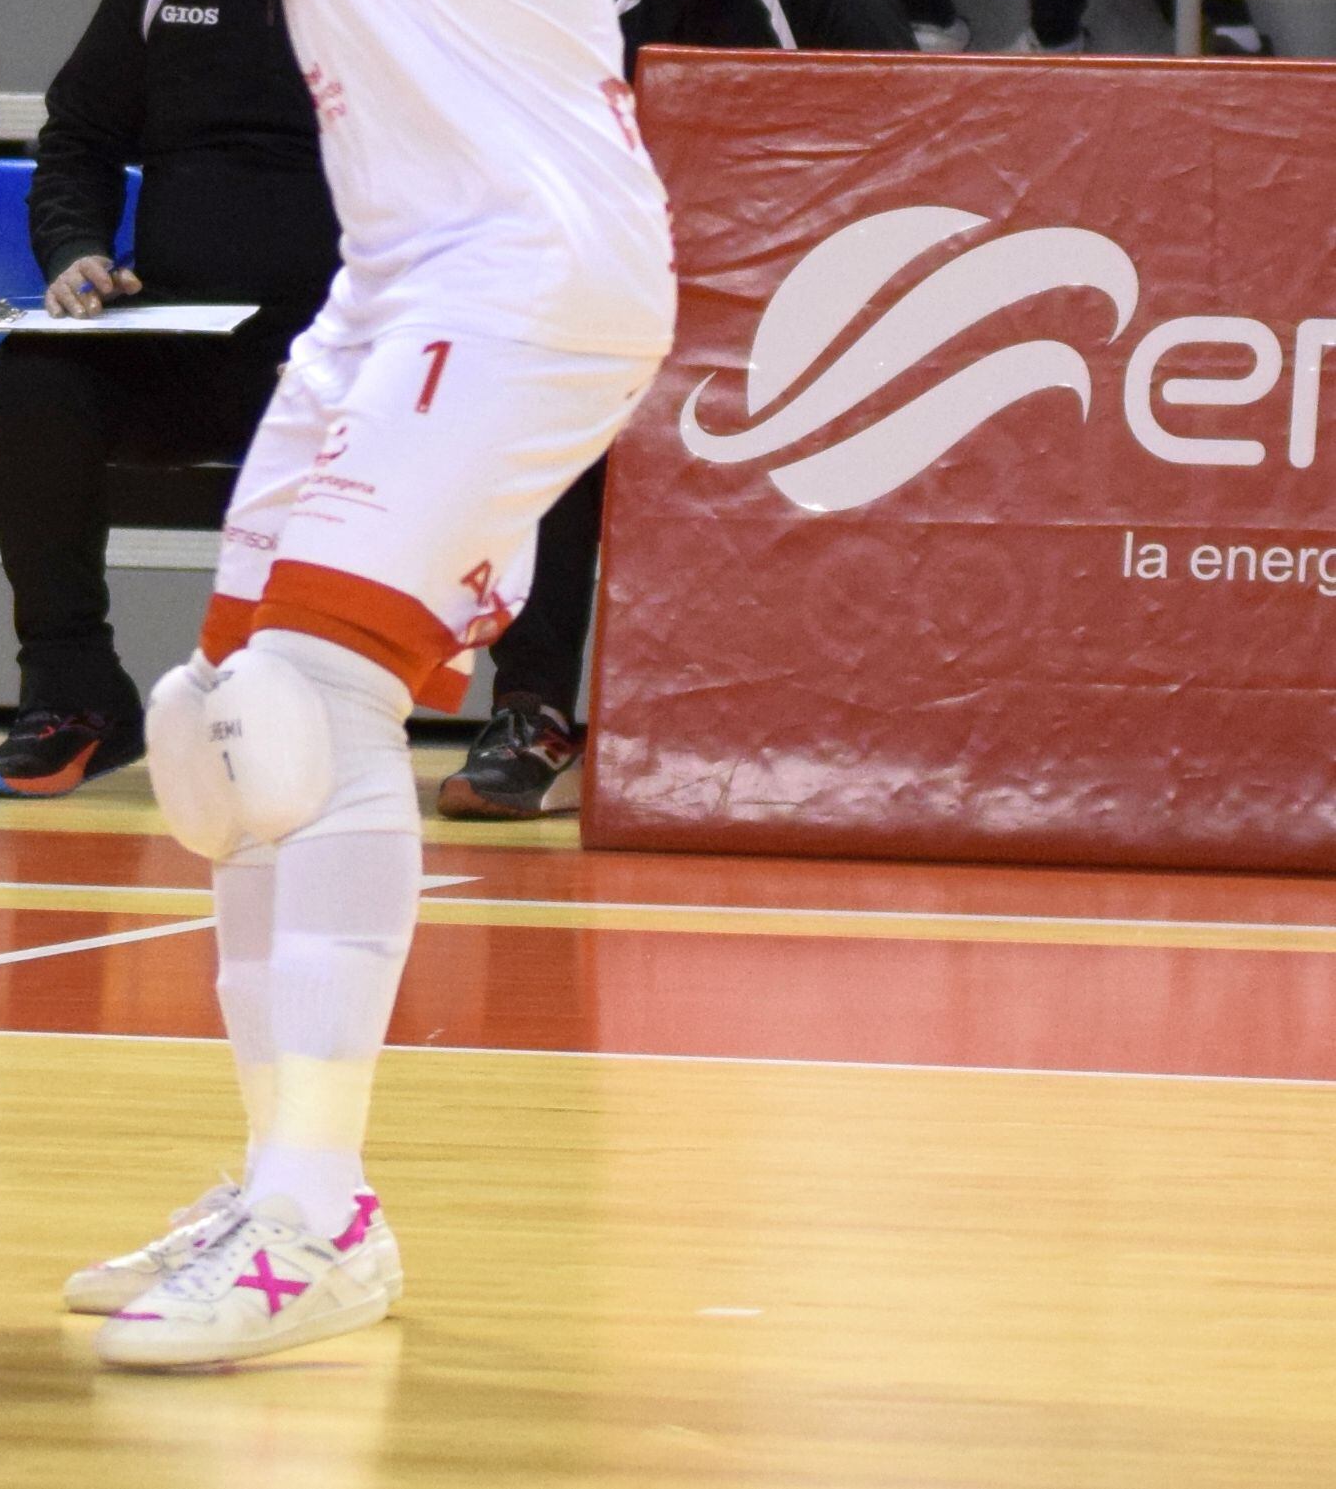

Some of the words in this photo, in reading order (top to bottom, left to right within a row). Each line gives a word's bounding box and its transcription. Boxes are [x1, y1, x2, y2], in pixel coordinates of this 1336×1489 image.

[161, 4, 220, 25] GIOS
[413, 340, 452, 414] 1
[1123, 531, 1168, 579] la
[1190, 543, 1336, 597] energ
